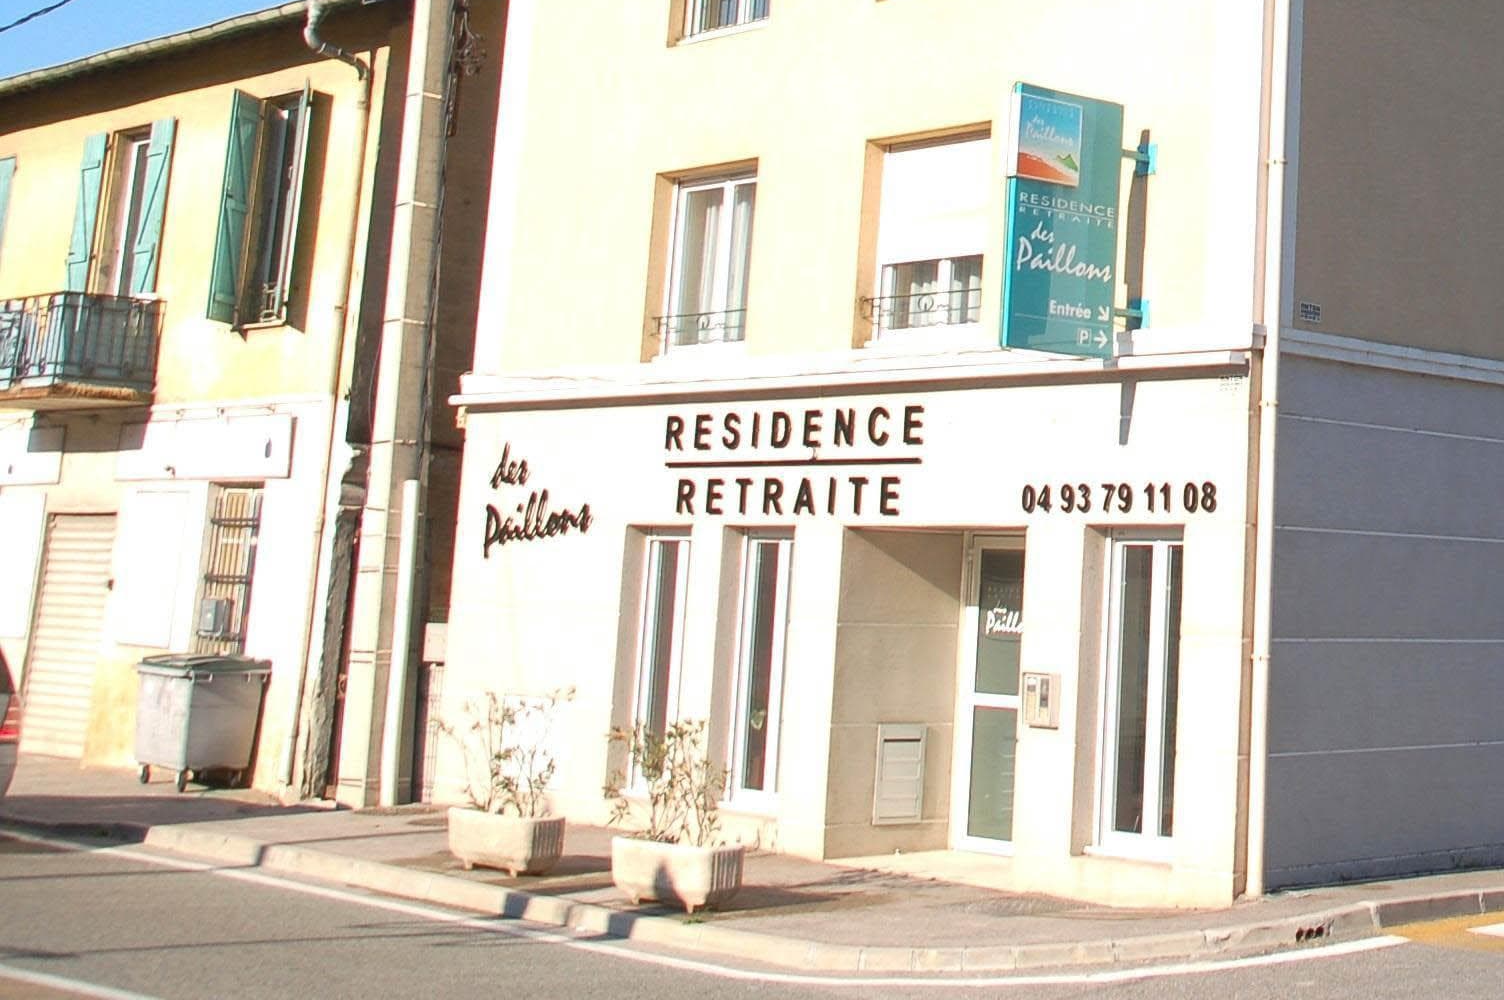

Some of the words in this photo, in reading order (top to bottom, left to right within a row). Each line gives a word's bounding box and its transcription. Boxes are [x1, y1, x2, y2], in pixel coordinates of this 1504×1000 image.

[1018, 206, 1114, 229] RETRAITE
[1019, 191, 1115, 218] RESIDENCE
[1030, 220, 1055, 243] des
[1017, 235, 1112, 282] Paillons
[1049, 299, 1092, 320] Entrée
[665, 405, 925, 451] RESIDENCE
[489, 440, 530, 490] des
[676, 476, 901, 516] RETRAITE
[1021, 483, 1052, 514] 04
[1060, 483, 1091, 514] 93
[1101, 482, 1133, 514] 79
[1143, 481, 1171, 514] 11
[1183, 481, 1217, 514] 08
[483, 488, 594, 560] Paillons
